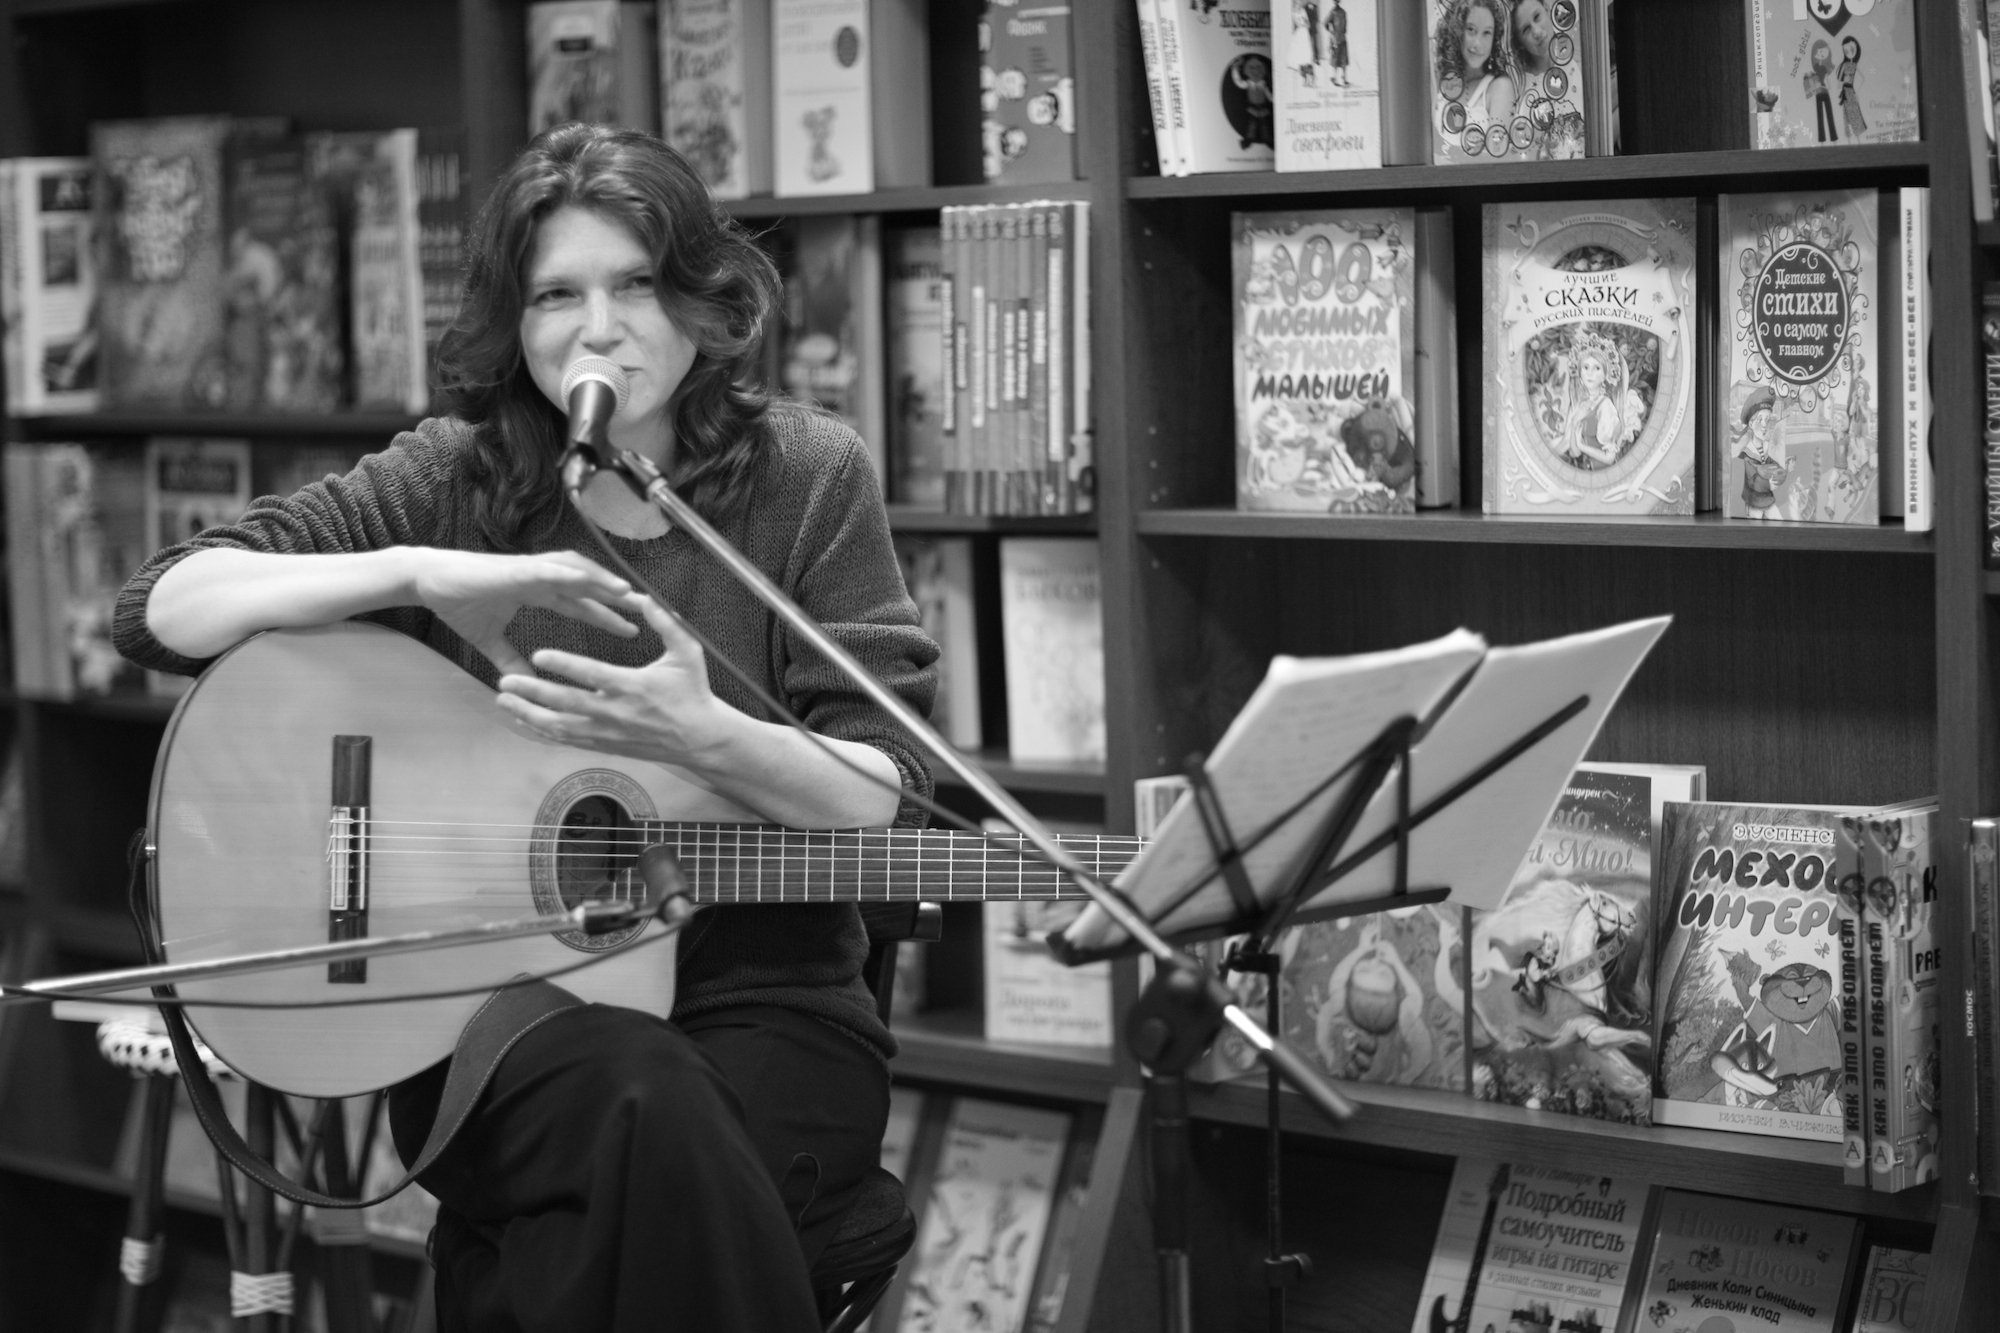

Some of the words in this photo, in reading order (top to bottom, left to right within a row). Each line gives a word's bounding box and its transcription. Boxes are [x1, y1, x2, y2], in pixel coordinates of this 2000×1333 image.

[1775, 268, 1826, 289] Детские
[1545, 286, 1639, 310] СКАЗКИ
[1254, 306, 1392, 337] ЛЮБИМЫХ
[1773, 323, 1782, 337] о
[1783, 322, 1828, 341] самом
[1778, 344, 1824, 358] главном
[1252, 367, 1389, 404] МАЛЫШЕЙ
[1986, 354, 2000, 434] СМЕРТИ
[1908, 419, 1918, 514] ВИННИ-ПУХ
[1734, 825, 1836, 844] Э.УСПЕНС
[1553, 837, 1633, 874] Мио!
[1847, 1094, 1860, 1131] КАК
[1874, 1098, 1887, 1136] КАК
[1506, 1182, 1627, 1222] Подробный
[1499, 1216, 1625, 1253] самоучитель
[1675, 1208, 1761, 1245] Носов
[1492, 1244, 1535, 1269] игры
[1538, 1251, 1560, 1271] на
[1562, 1257, 1619, 1283] гитаре
[1730, 1248, 1818, 1287] Носов
[1667, 1278, 1719, 1294] Дневник
[1722, 1279, 1752, 1296] Коли
[1755, 1285, 1817, 1318] Синицына
[1691, 1294, 1747, 1313] Женькин
[1750, 1305, 1781, 1325] клад
